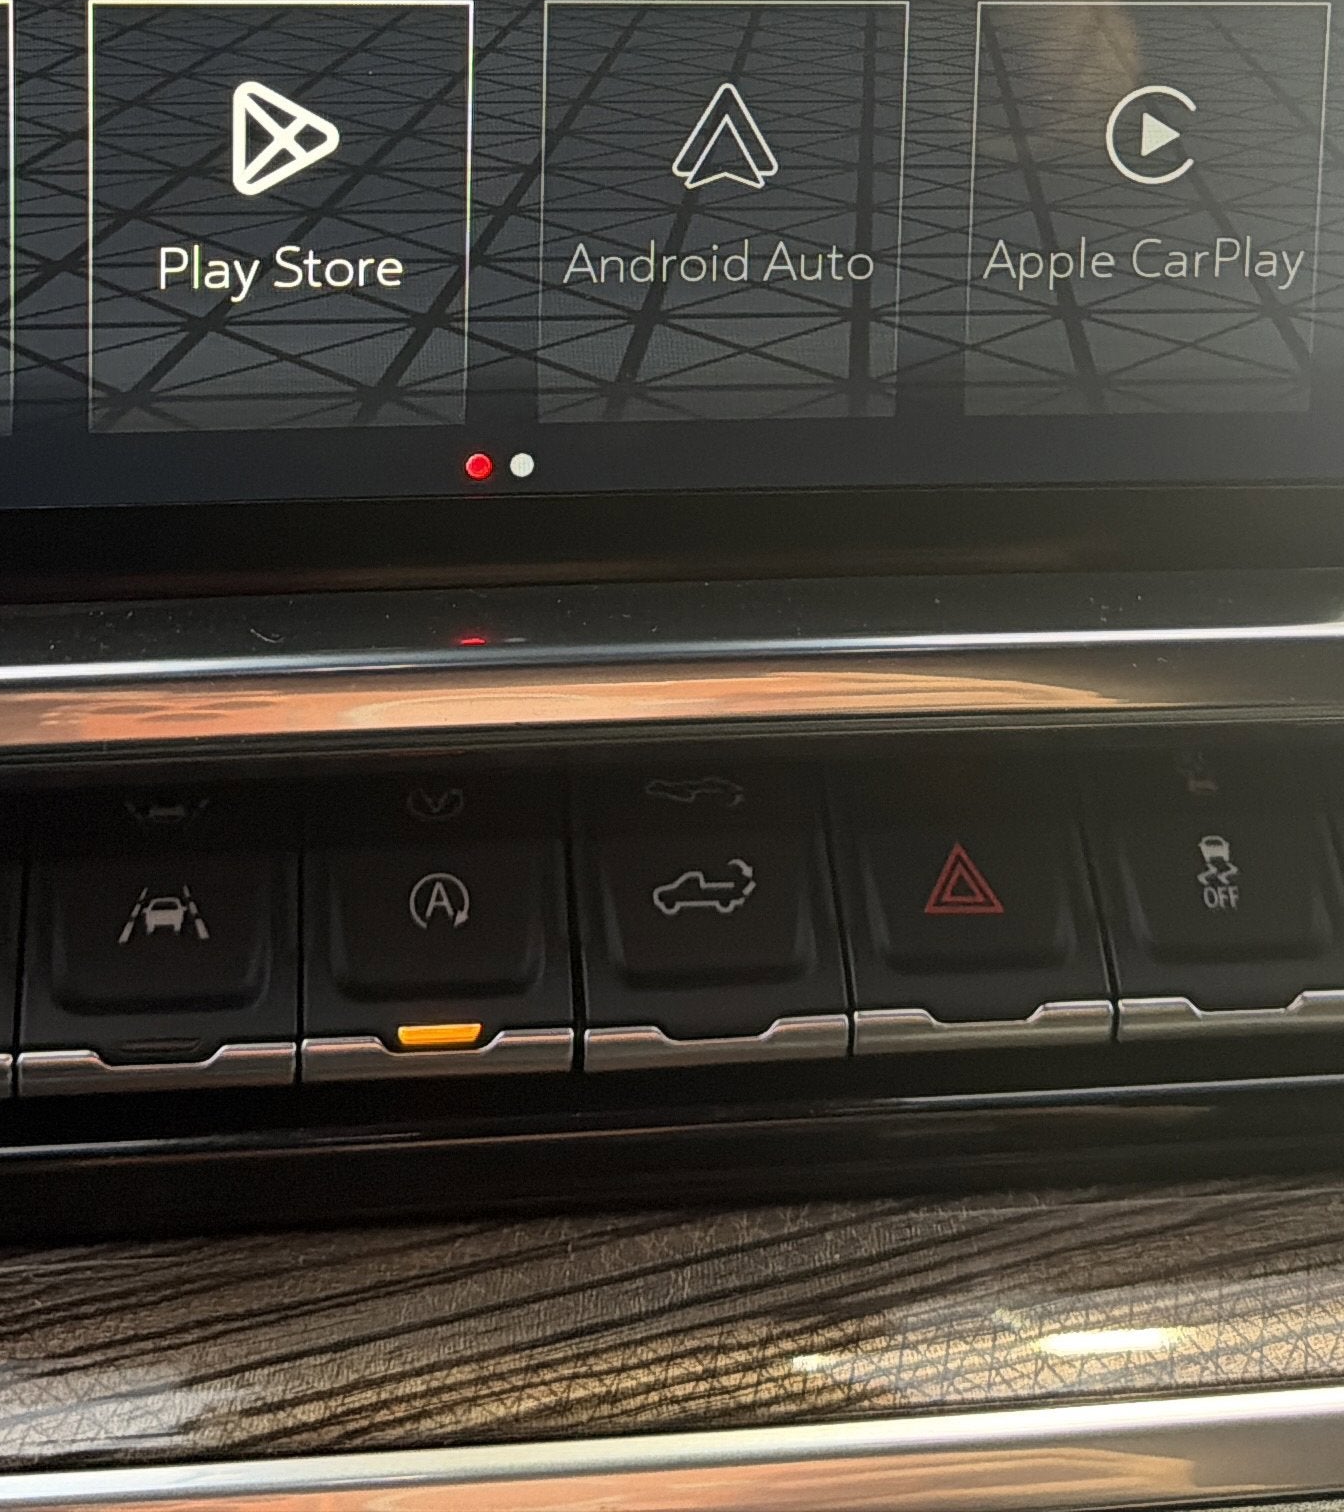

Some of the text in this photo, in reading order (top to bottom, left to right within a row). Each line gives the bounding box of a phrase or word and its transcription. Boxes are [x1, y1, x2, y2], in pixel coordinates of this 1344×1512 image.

[159, 244, 404, 303] Play Store
[562, 238, 875, 285] Android Auto
[982, 235, 1305, 290] Apple CarPlay
[1203, 886, 1240, 909] OFF
